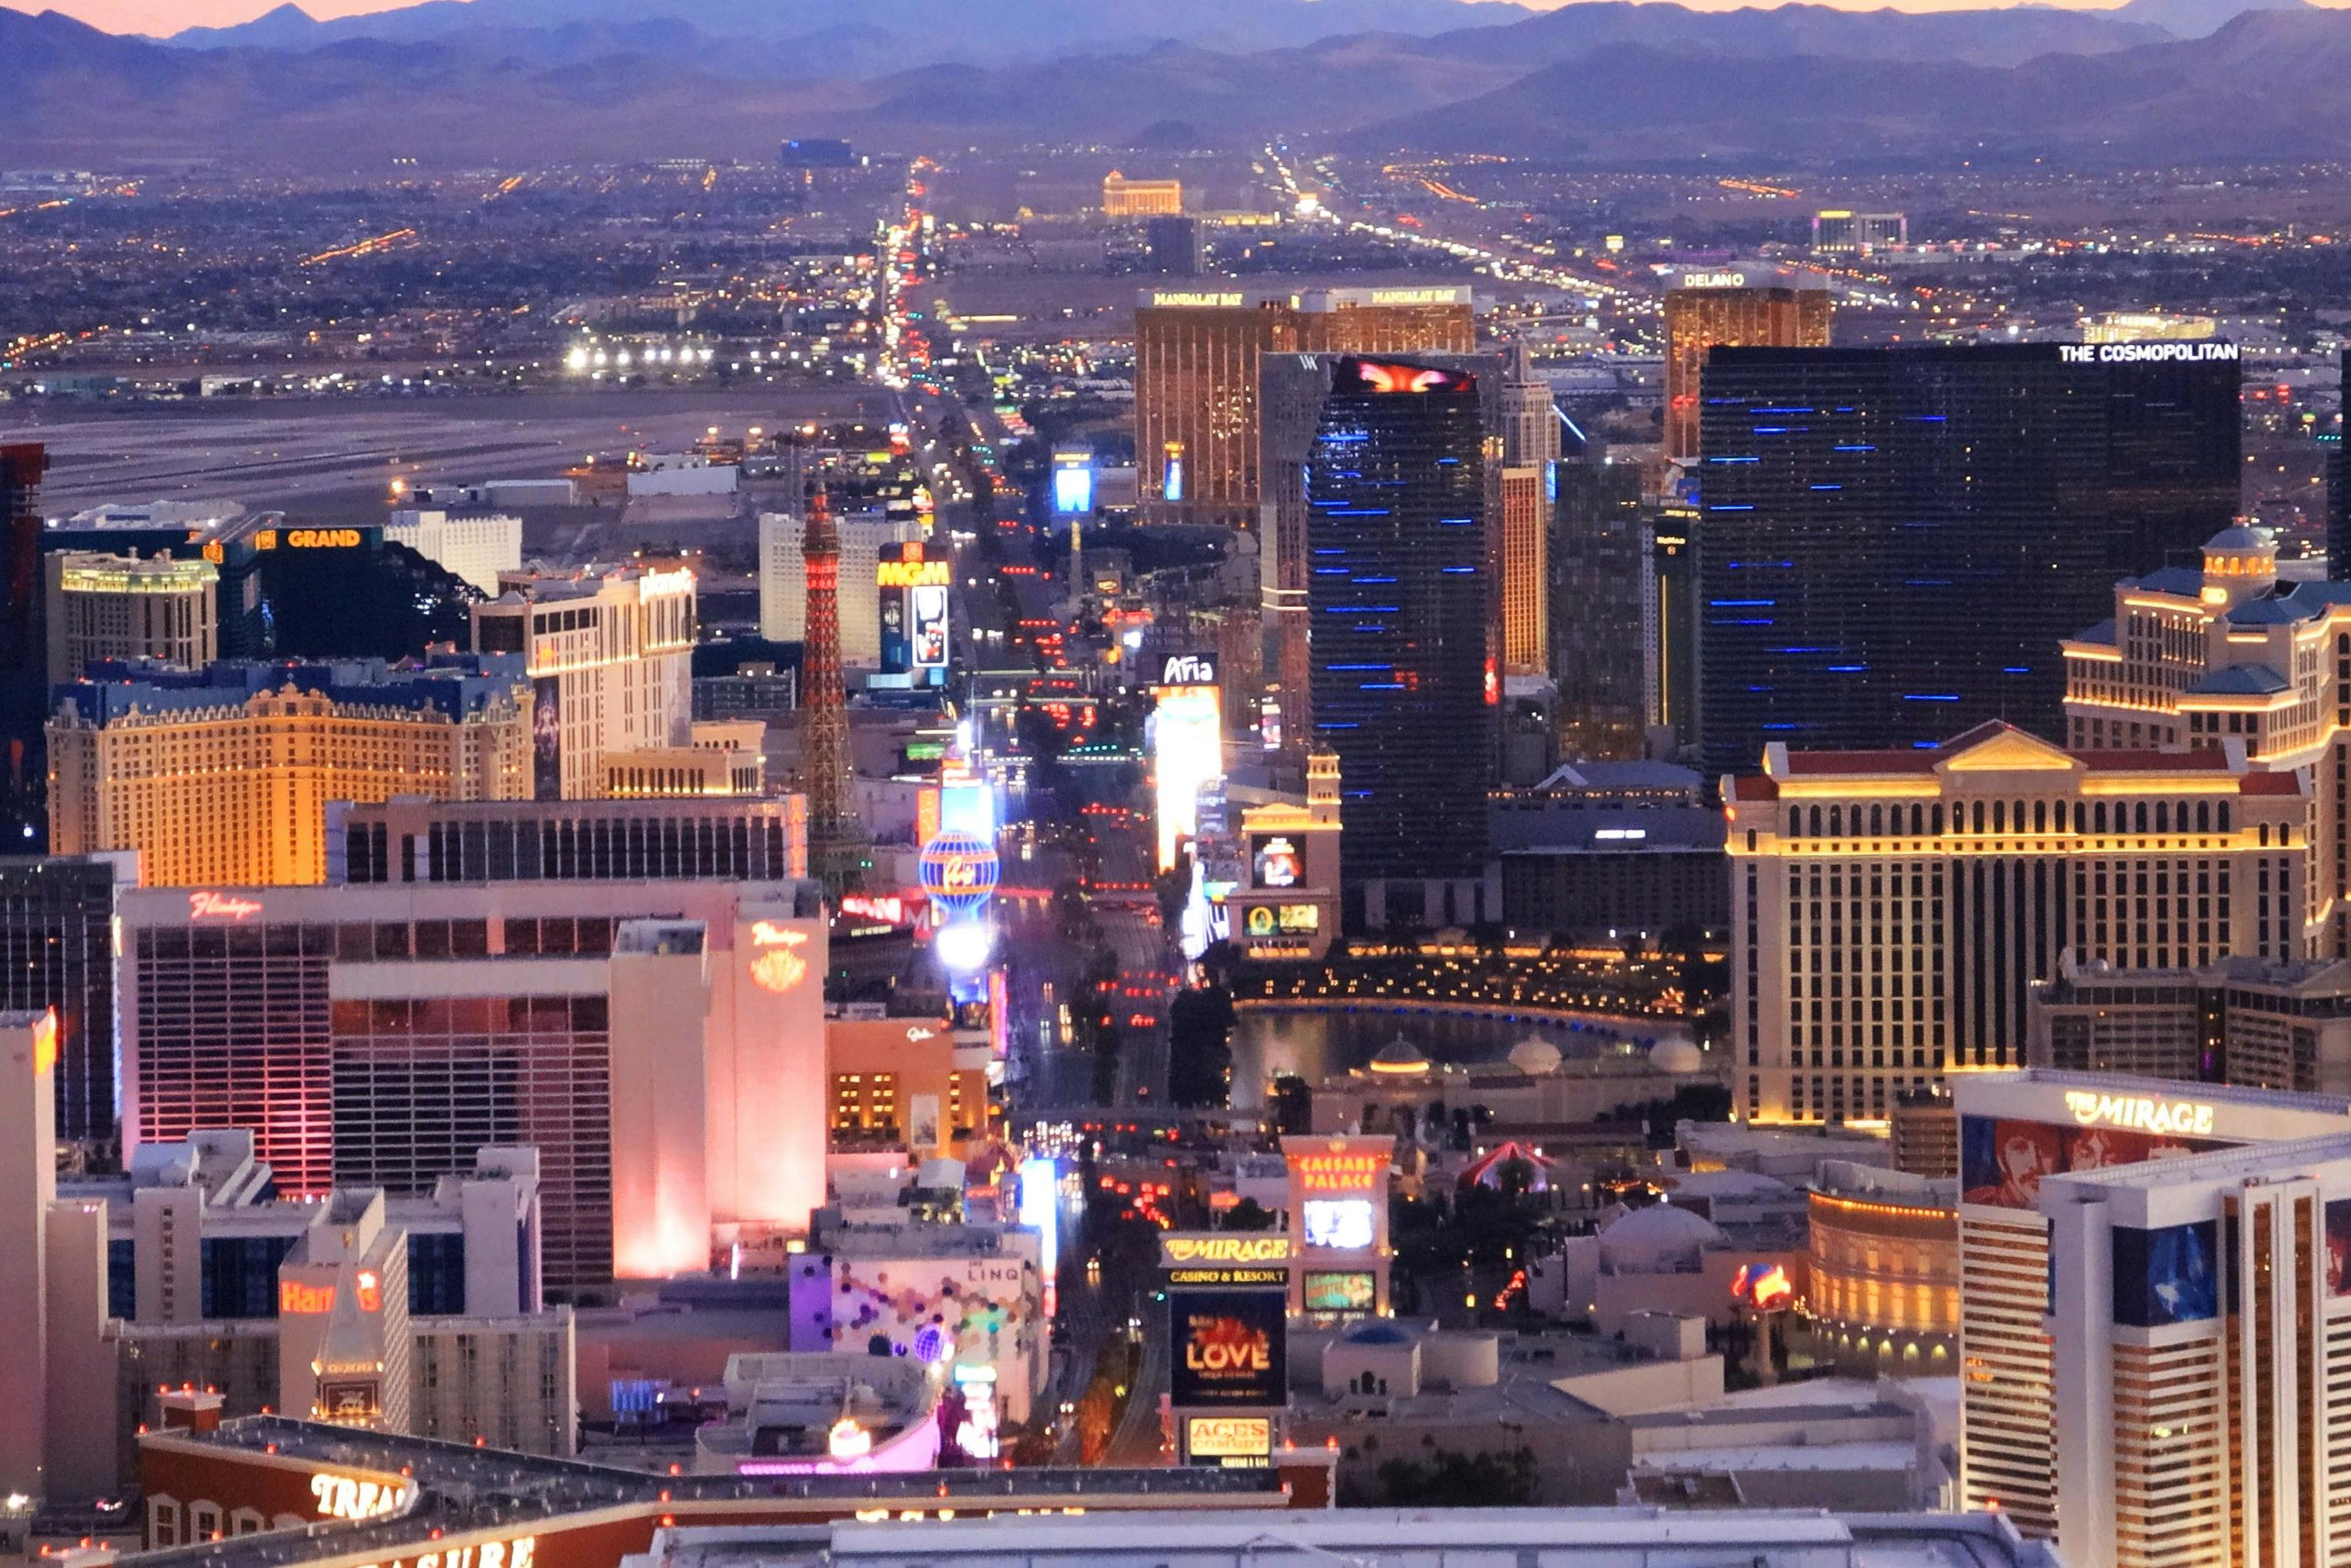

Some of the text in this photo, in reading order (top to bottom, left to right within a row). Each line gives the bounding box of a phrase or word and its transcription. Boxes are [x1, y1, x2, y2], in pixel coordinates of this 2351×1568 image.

[1684, 273, 1744, 287] DELANO
[1154, 292, 1242, 307] MANDALAY BAY
[1372, 290, 1456, 303] MANDALAY BAY
[2059, 343, 2238, 362] THE COSMOPOLITAN
[288, 530, 360, 547] GRAND
[877, 562, 950, 586] MGM
[1164, 655, 1213, 684] Aria
[2084, 1094, 2213, 1135] MIRAGE
[1300, 1158, 1377, 1172] CAESARS
[1305, 1174, 1373, 1188] PALACE
[1166, 1238, 1289, 1262] THE MIRAGE
[968, 1268, 1018, 1281] LINQ
[1170, 1270, 1285, 1282] CASINO & RESORT
[1186, 1342, 1271, 1370] LOVE
[1192, 1423, 1268, 1437] ACES
